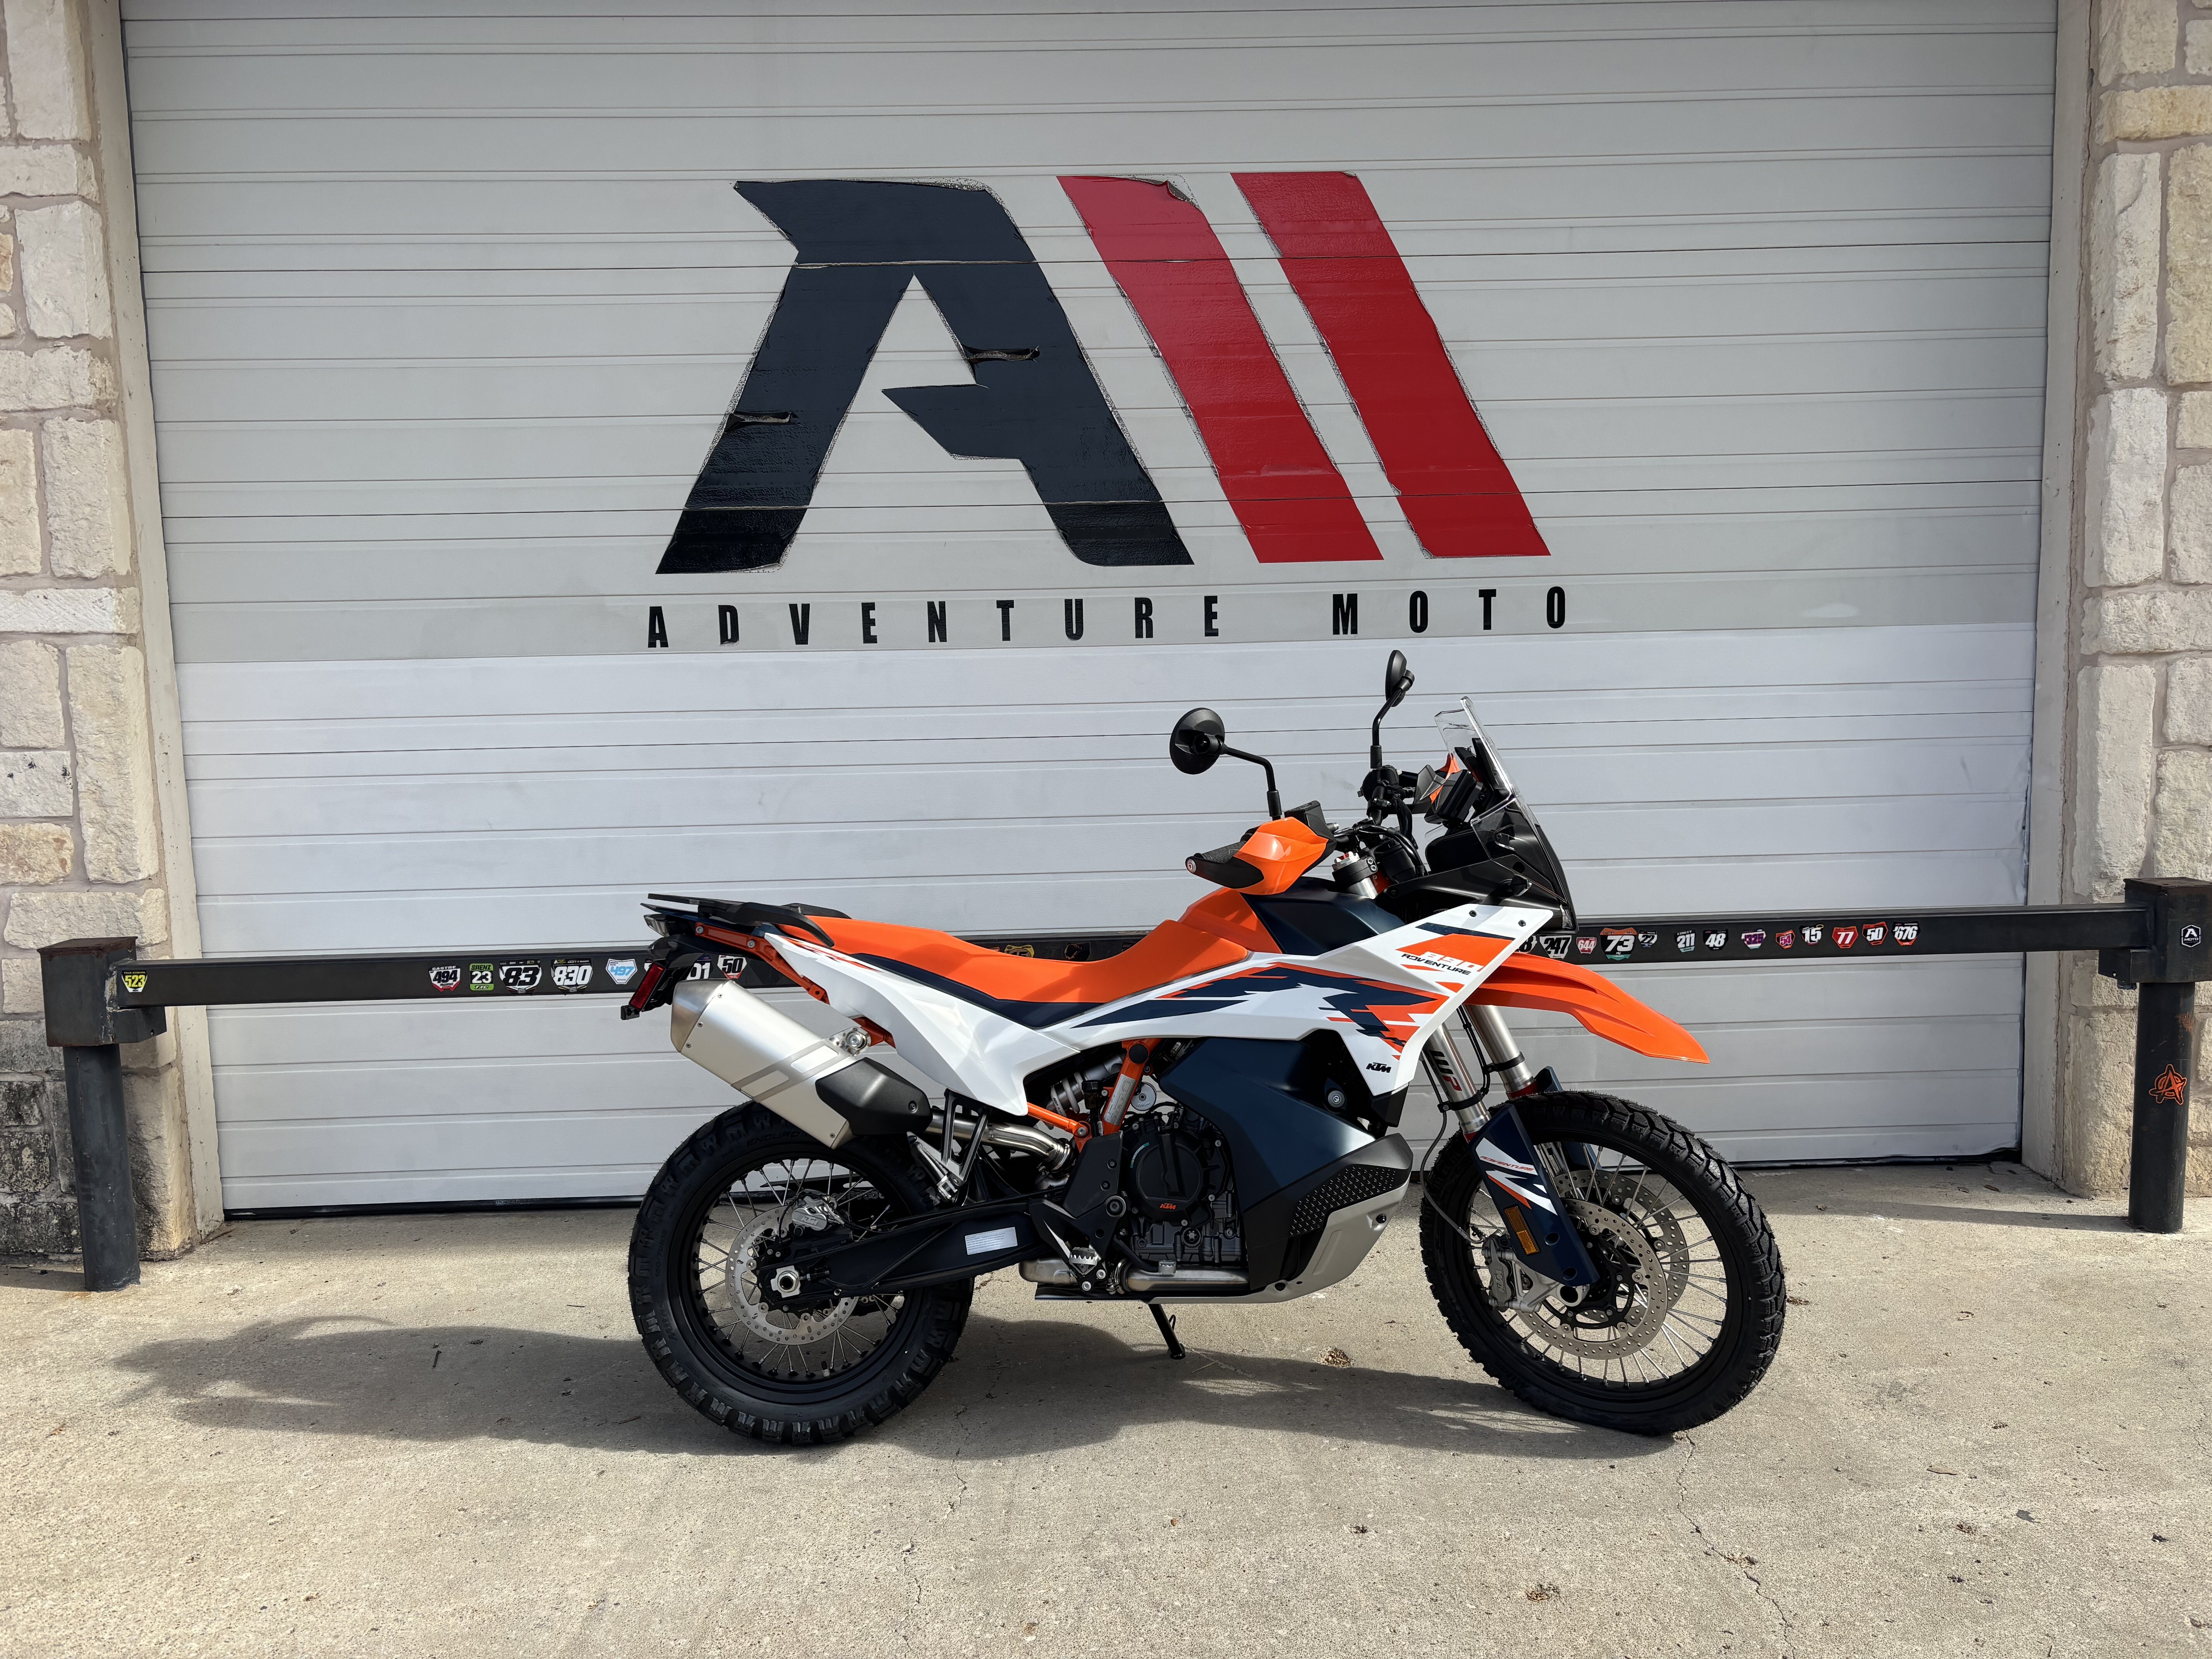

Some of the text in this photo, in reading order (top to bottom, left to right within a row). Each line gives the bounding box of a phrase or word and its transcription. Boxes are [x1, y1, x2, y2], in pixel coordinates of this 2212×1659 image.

[648, 586, 1566, 648] ADVENTURE MOTO
[1641, 934, 1655, 944] 22
[1677, 933, 1695, 948] 211
[1705, 933, 1726, 947] 48
[1779, 934, 1792, 946] 54
[1802, 927, 1822, 944] 15
[1837, 931, 1854, 944] 77
[1866, 927, 1884, 941] 50
[1544, 937, 1571, 954] 247
[1578, 939, 1594, 950] 644
[1604, 935, 1635, 952] 73
[610, 966, 634, 975] 497
[722, 958, 744, 974] 50
[1401, 953, 1471, 975] ADVENTURE
[125, 975, 145, 987] 523
[433, 970, 458, 983] 494
[472, 971, 491, 984] 23
[502, 967, 540, 986] 83
[553, 965, 592, 986] 830
[1366, 1062, 1391, 1073] KTM
[1480, 1156, 1535, 1171] ADVENTURE
